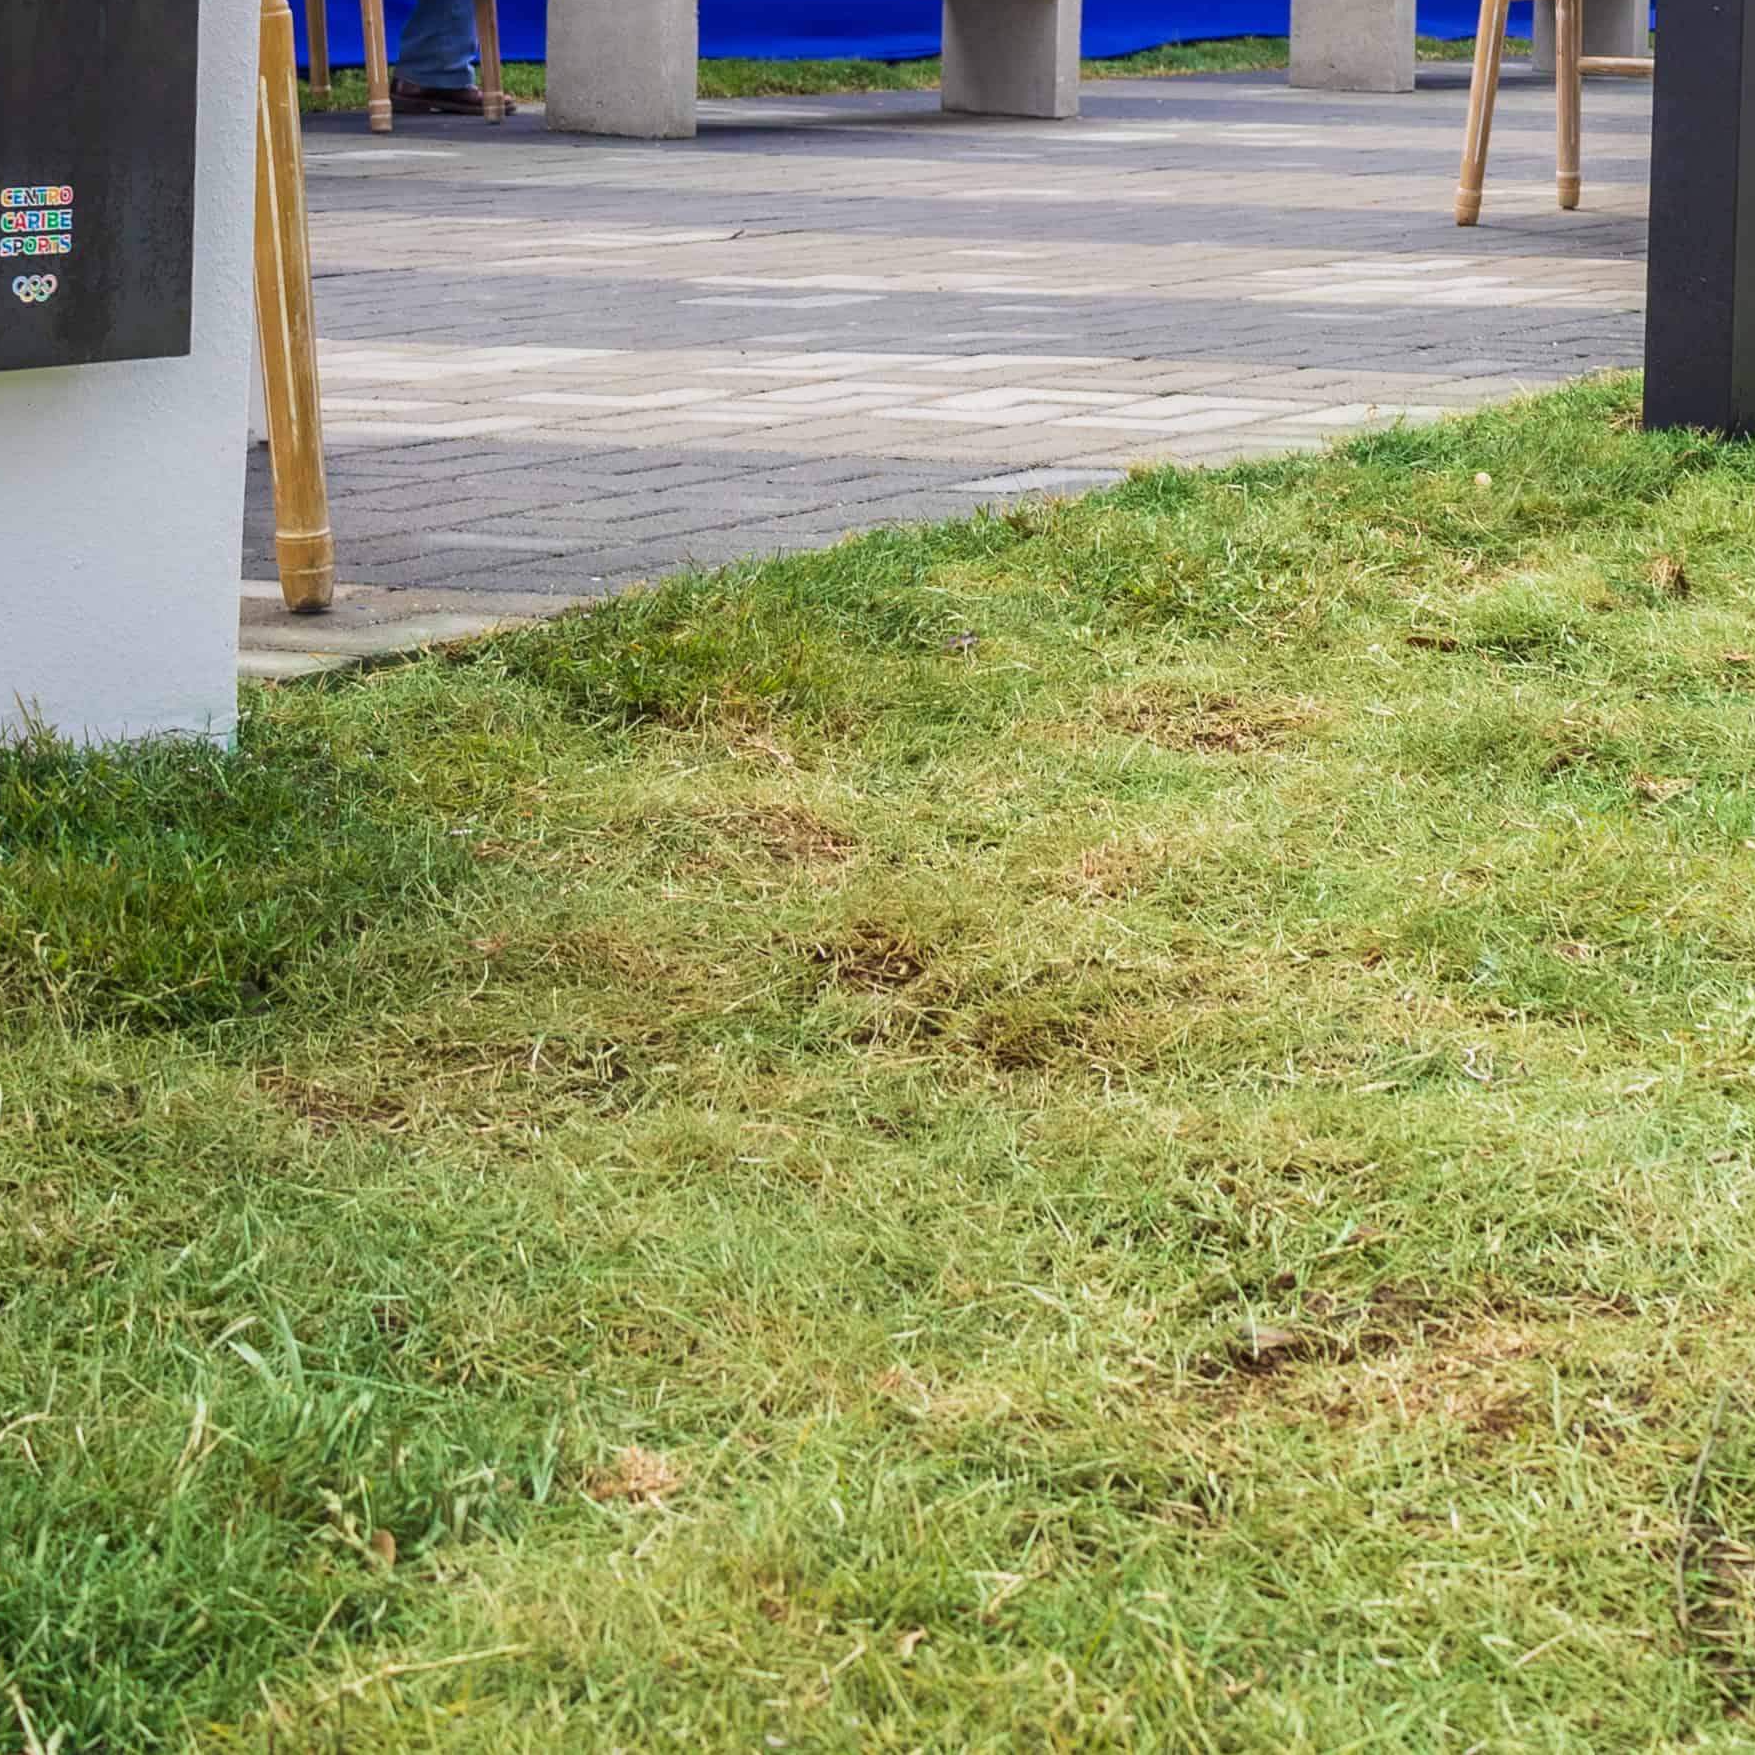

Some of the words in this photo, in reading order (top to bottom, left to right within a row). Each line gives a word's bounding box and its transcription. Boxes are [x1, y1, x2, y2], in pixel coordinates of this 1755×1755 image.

[0, 186, 73, 207] CENTRO
[0, 209, 73, 232] CARIBE
[0, 234, 72, 257] SPORTS
